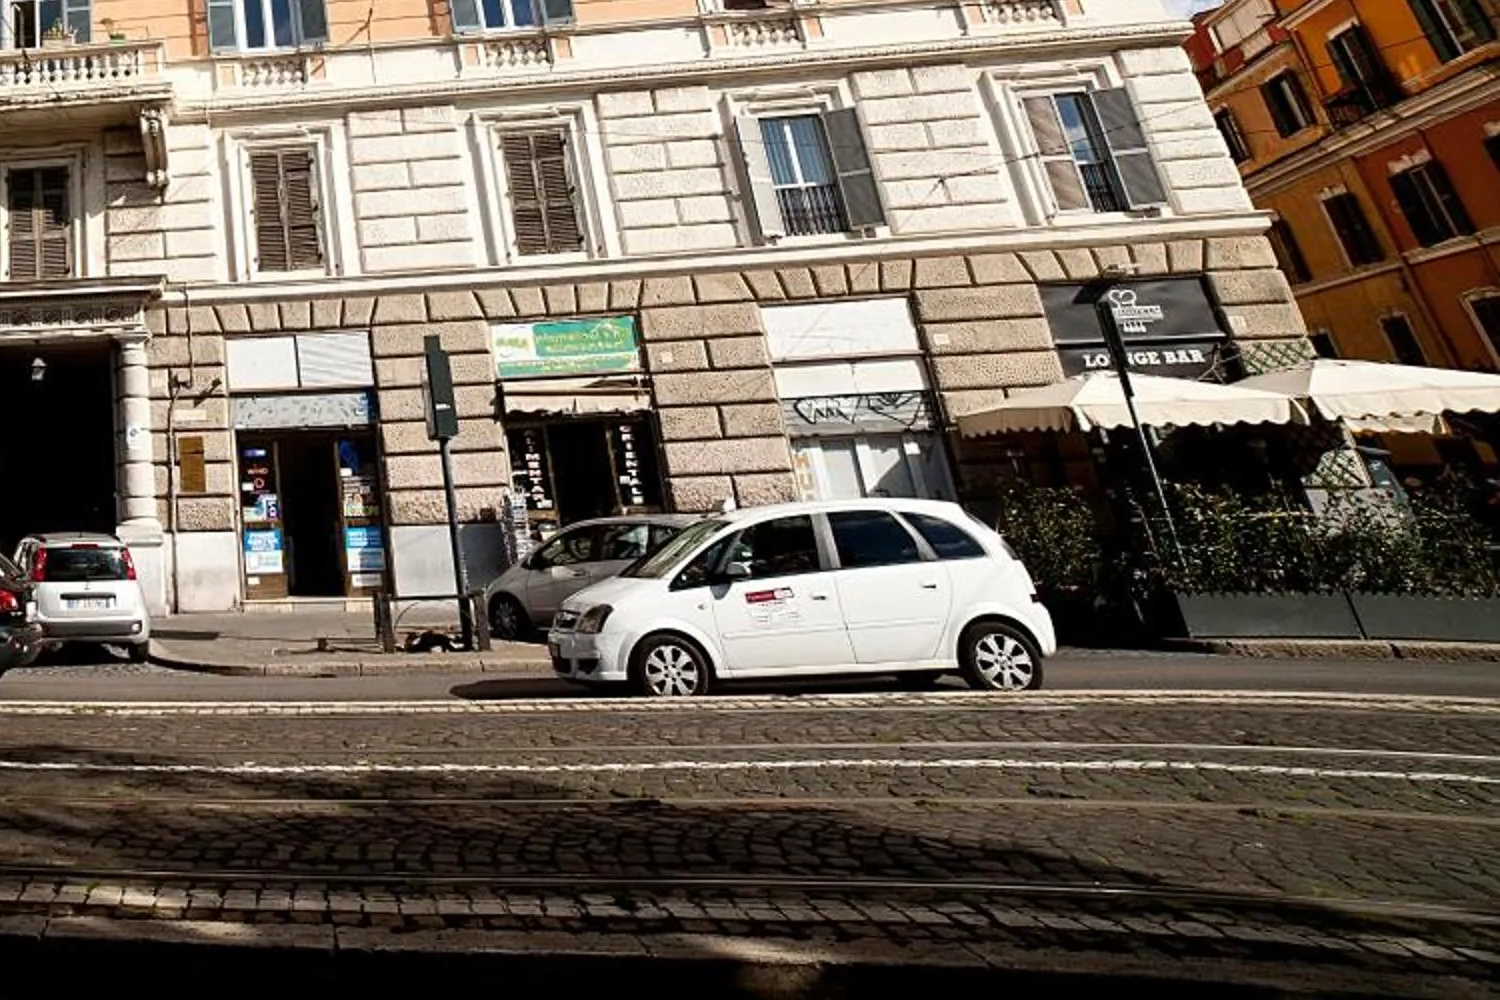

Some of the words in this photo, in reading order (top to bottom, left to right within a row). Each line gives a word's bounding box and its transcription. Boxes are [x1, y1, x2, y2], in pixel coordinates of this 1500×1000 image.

[1082, 351, 1160, 368] LONGE
[1162, 349, 1206, 365] BAR
[524, 430, 549, 507] ALIMENTAR
